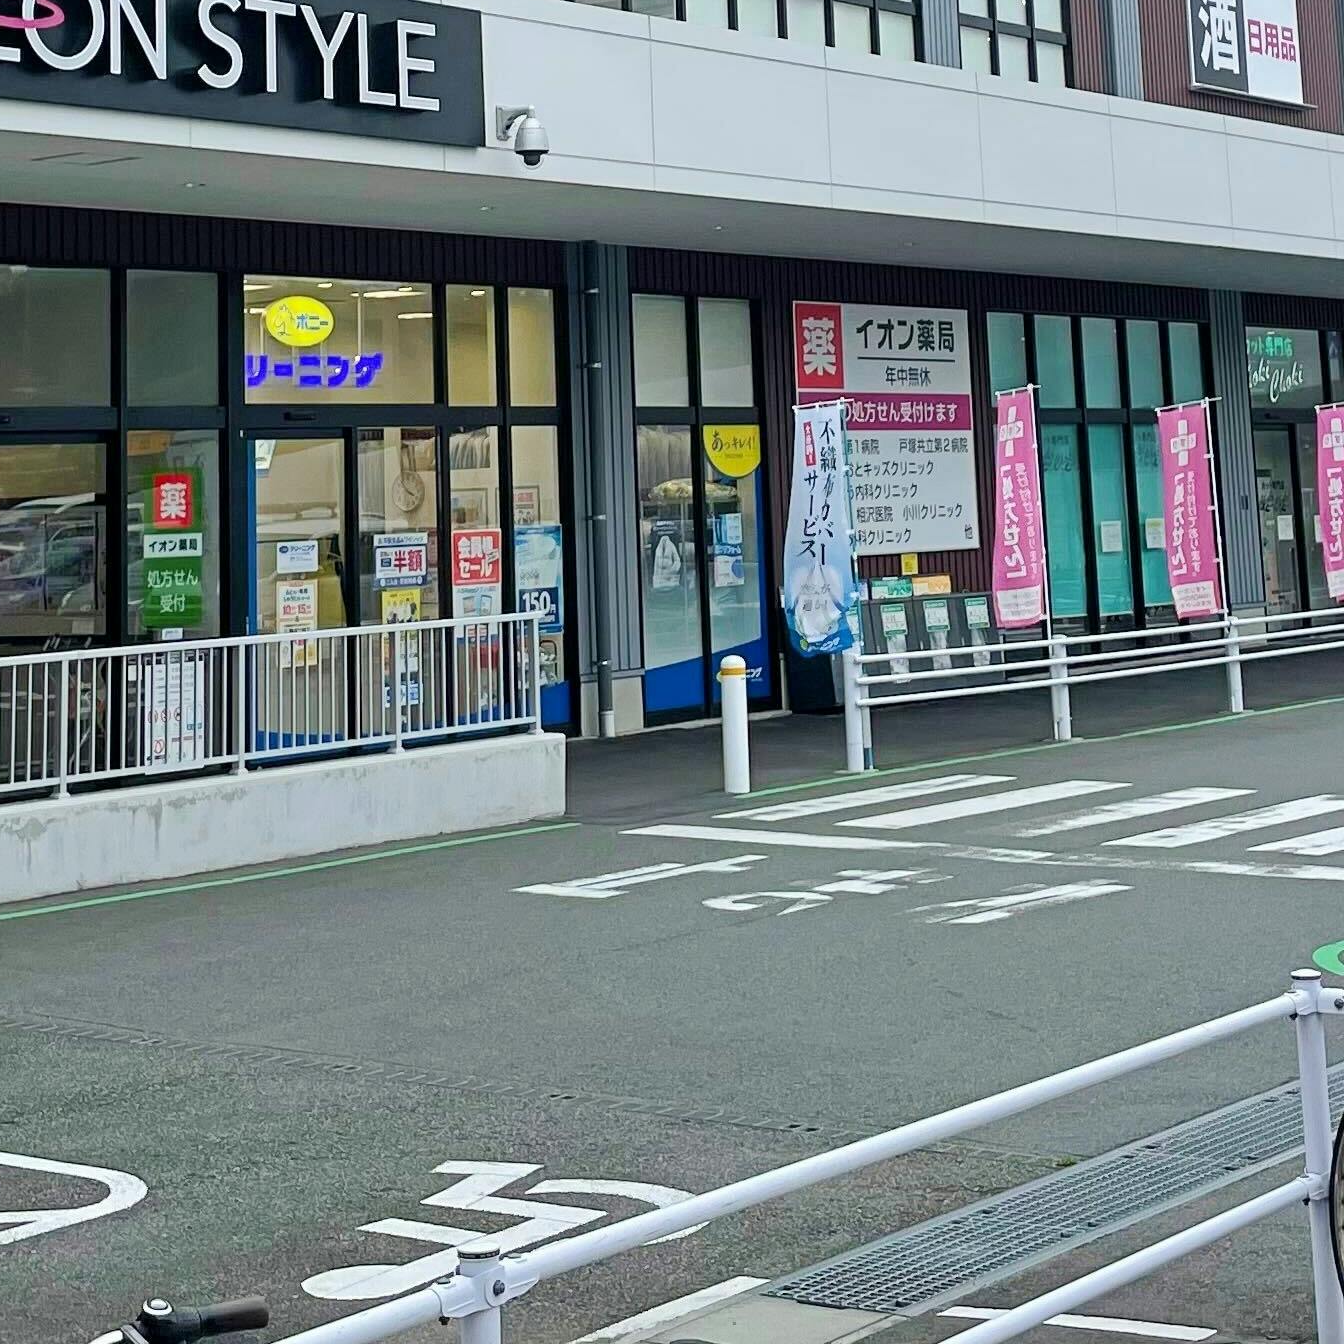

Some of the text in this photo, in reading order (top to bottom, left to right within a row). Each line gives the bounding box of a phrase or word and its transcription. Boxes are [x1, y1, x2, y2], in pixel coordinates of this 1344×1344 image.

[1247, 20, 1297, 63] 日用品
[802, 316, 837, 376] 薬
[855, 318, 955, 353] イオン薬局
[885, 365, 932, 386] 年中無休
[1269, 361, 1304, 404] Choki
[899, 437, 969, 454] 戸塚共立第2病院
[159, 482, 187, 520] 薬
[796, 470, 819, 559] サービス
[902, 504, 963, 522] 小川クリニック
[148, 537, 198, 553] イオン薬局
[393, 549, 423, 574] 半額
[459, 559, 493, 579] セール
[147, 569, 198, 589] 処方せん
[159, 594, 186, 614] 受付
